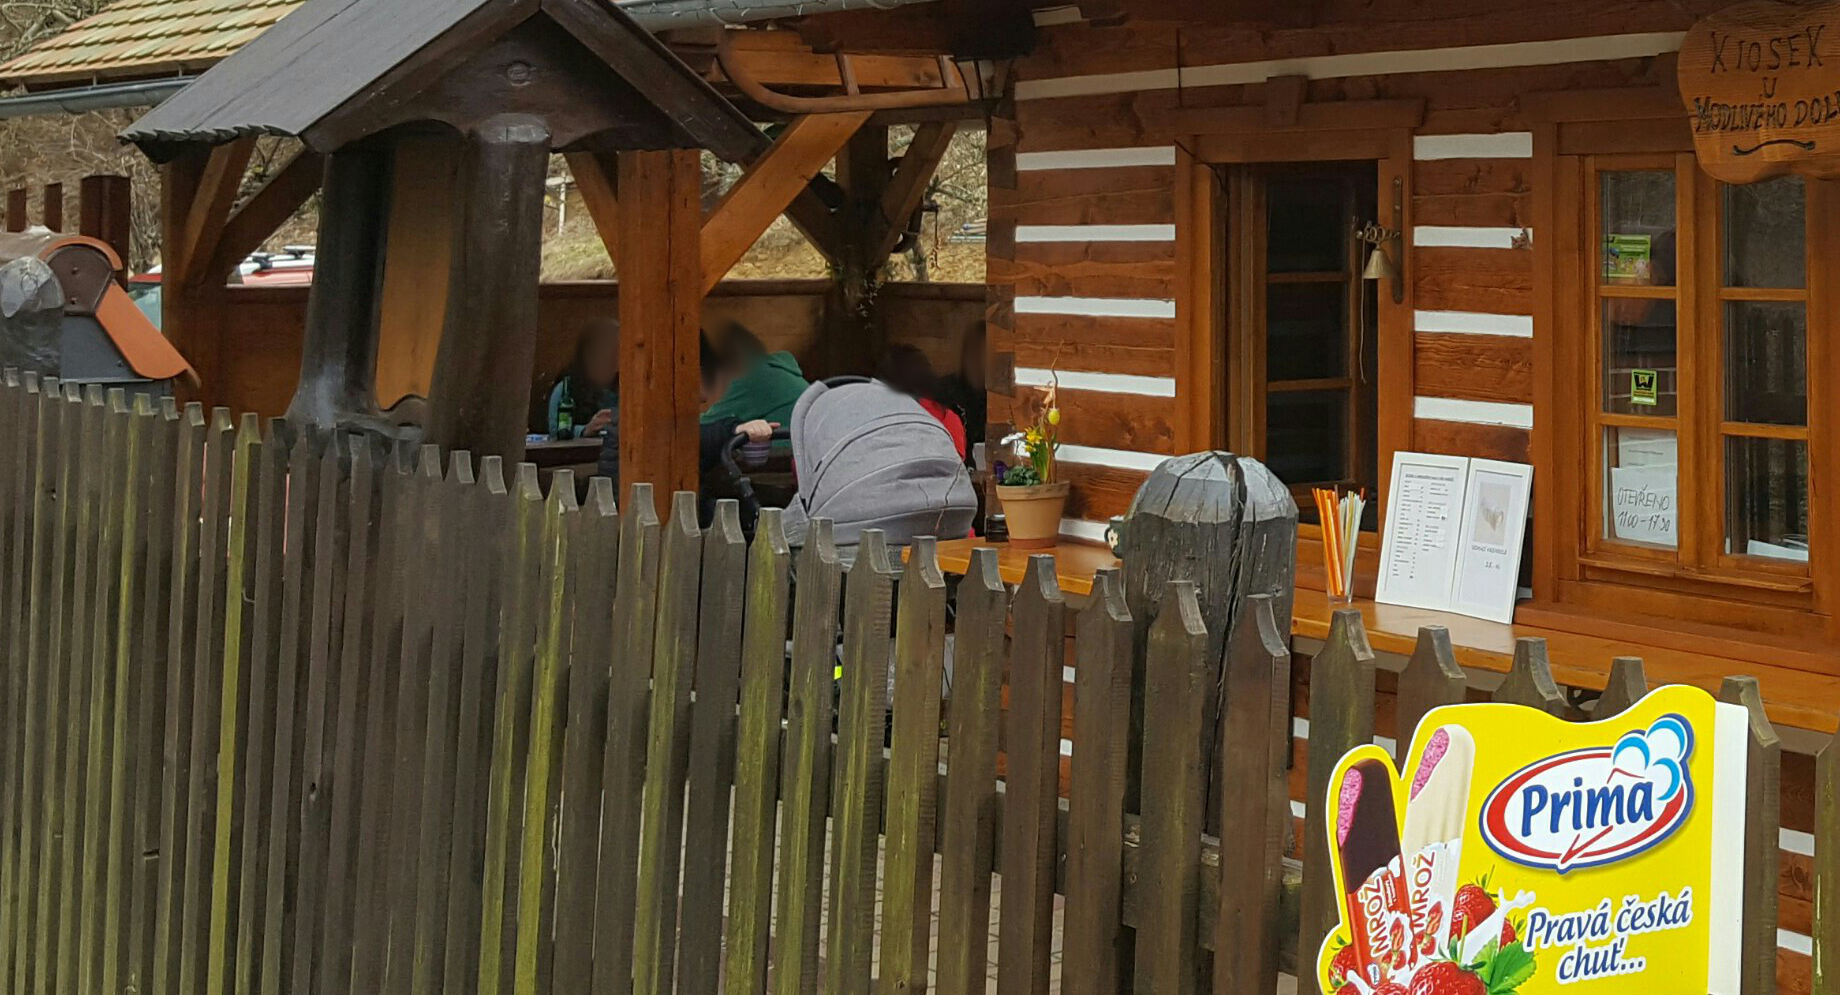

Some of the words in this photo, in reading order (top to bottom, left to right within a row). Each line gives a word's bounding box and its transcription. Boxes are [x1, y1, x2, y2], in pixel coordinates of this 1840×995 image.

[1710, 24, 1826, 74] KIOSEK
[1763, 77, 1777, 99] U
[1617, 484, 1670, 511] OTEVŘENO
[1521, 776, 1653, 837] Prima
[1359, 878, 1390, 955] MROŽ
[1411, 851, 1435, 928] MROŽ
[1526, 902, 1609, 947] Pravá
[1616, 890, 1690, 933] česká
